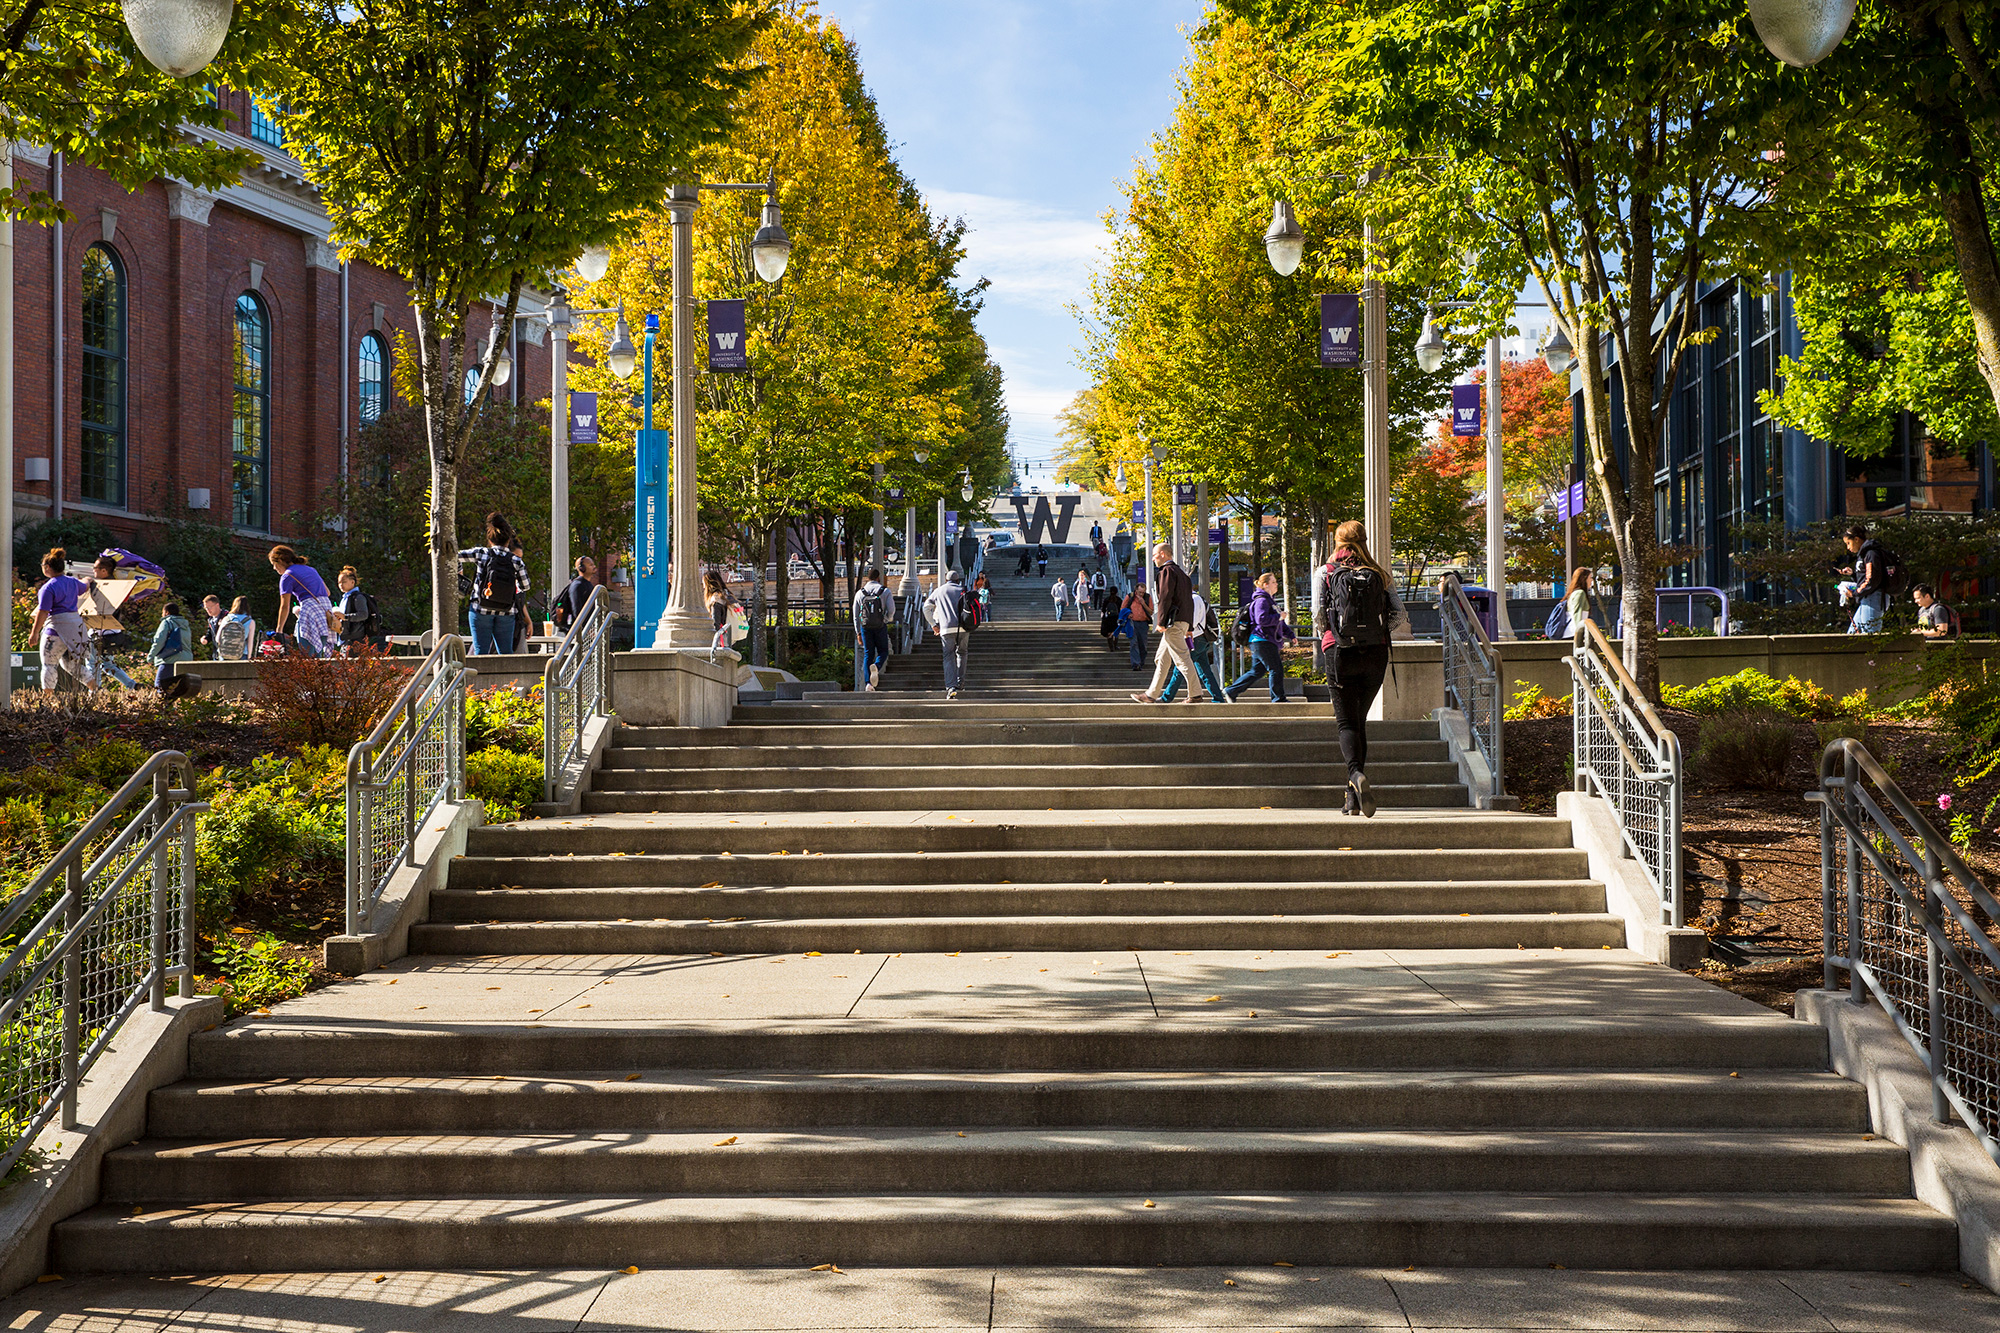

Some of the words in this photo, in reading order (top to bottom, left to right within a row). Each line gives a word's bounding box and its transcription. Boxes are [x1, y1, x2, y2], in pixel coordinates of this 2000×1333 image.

[715, 332, 738, 350] W
[1328, 327, 1352, 344] W
[575, 414, 593, 427] W
[1458, 408, 1476, 420] W
[1180, 485, 1193, 494] W
[1009, 496, 1081, 544] W
